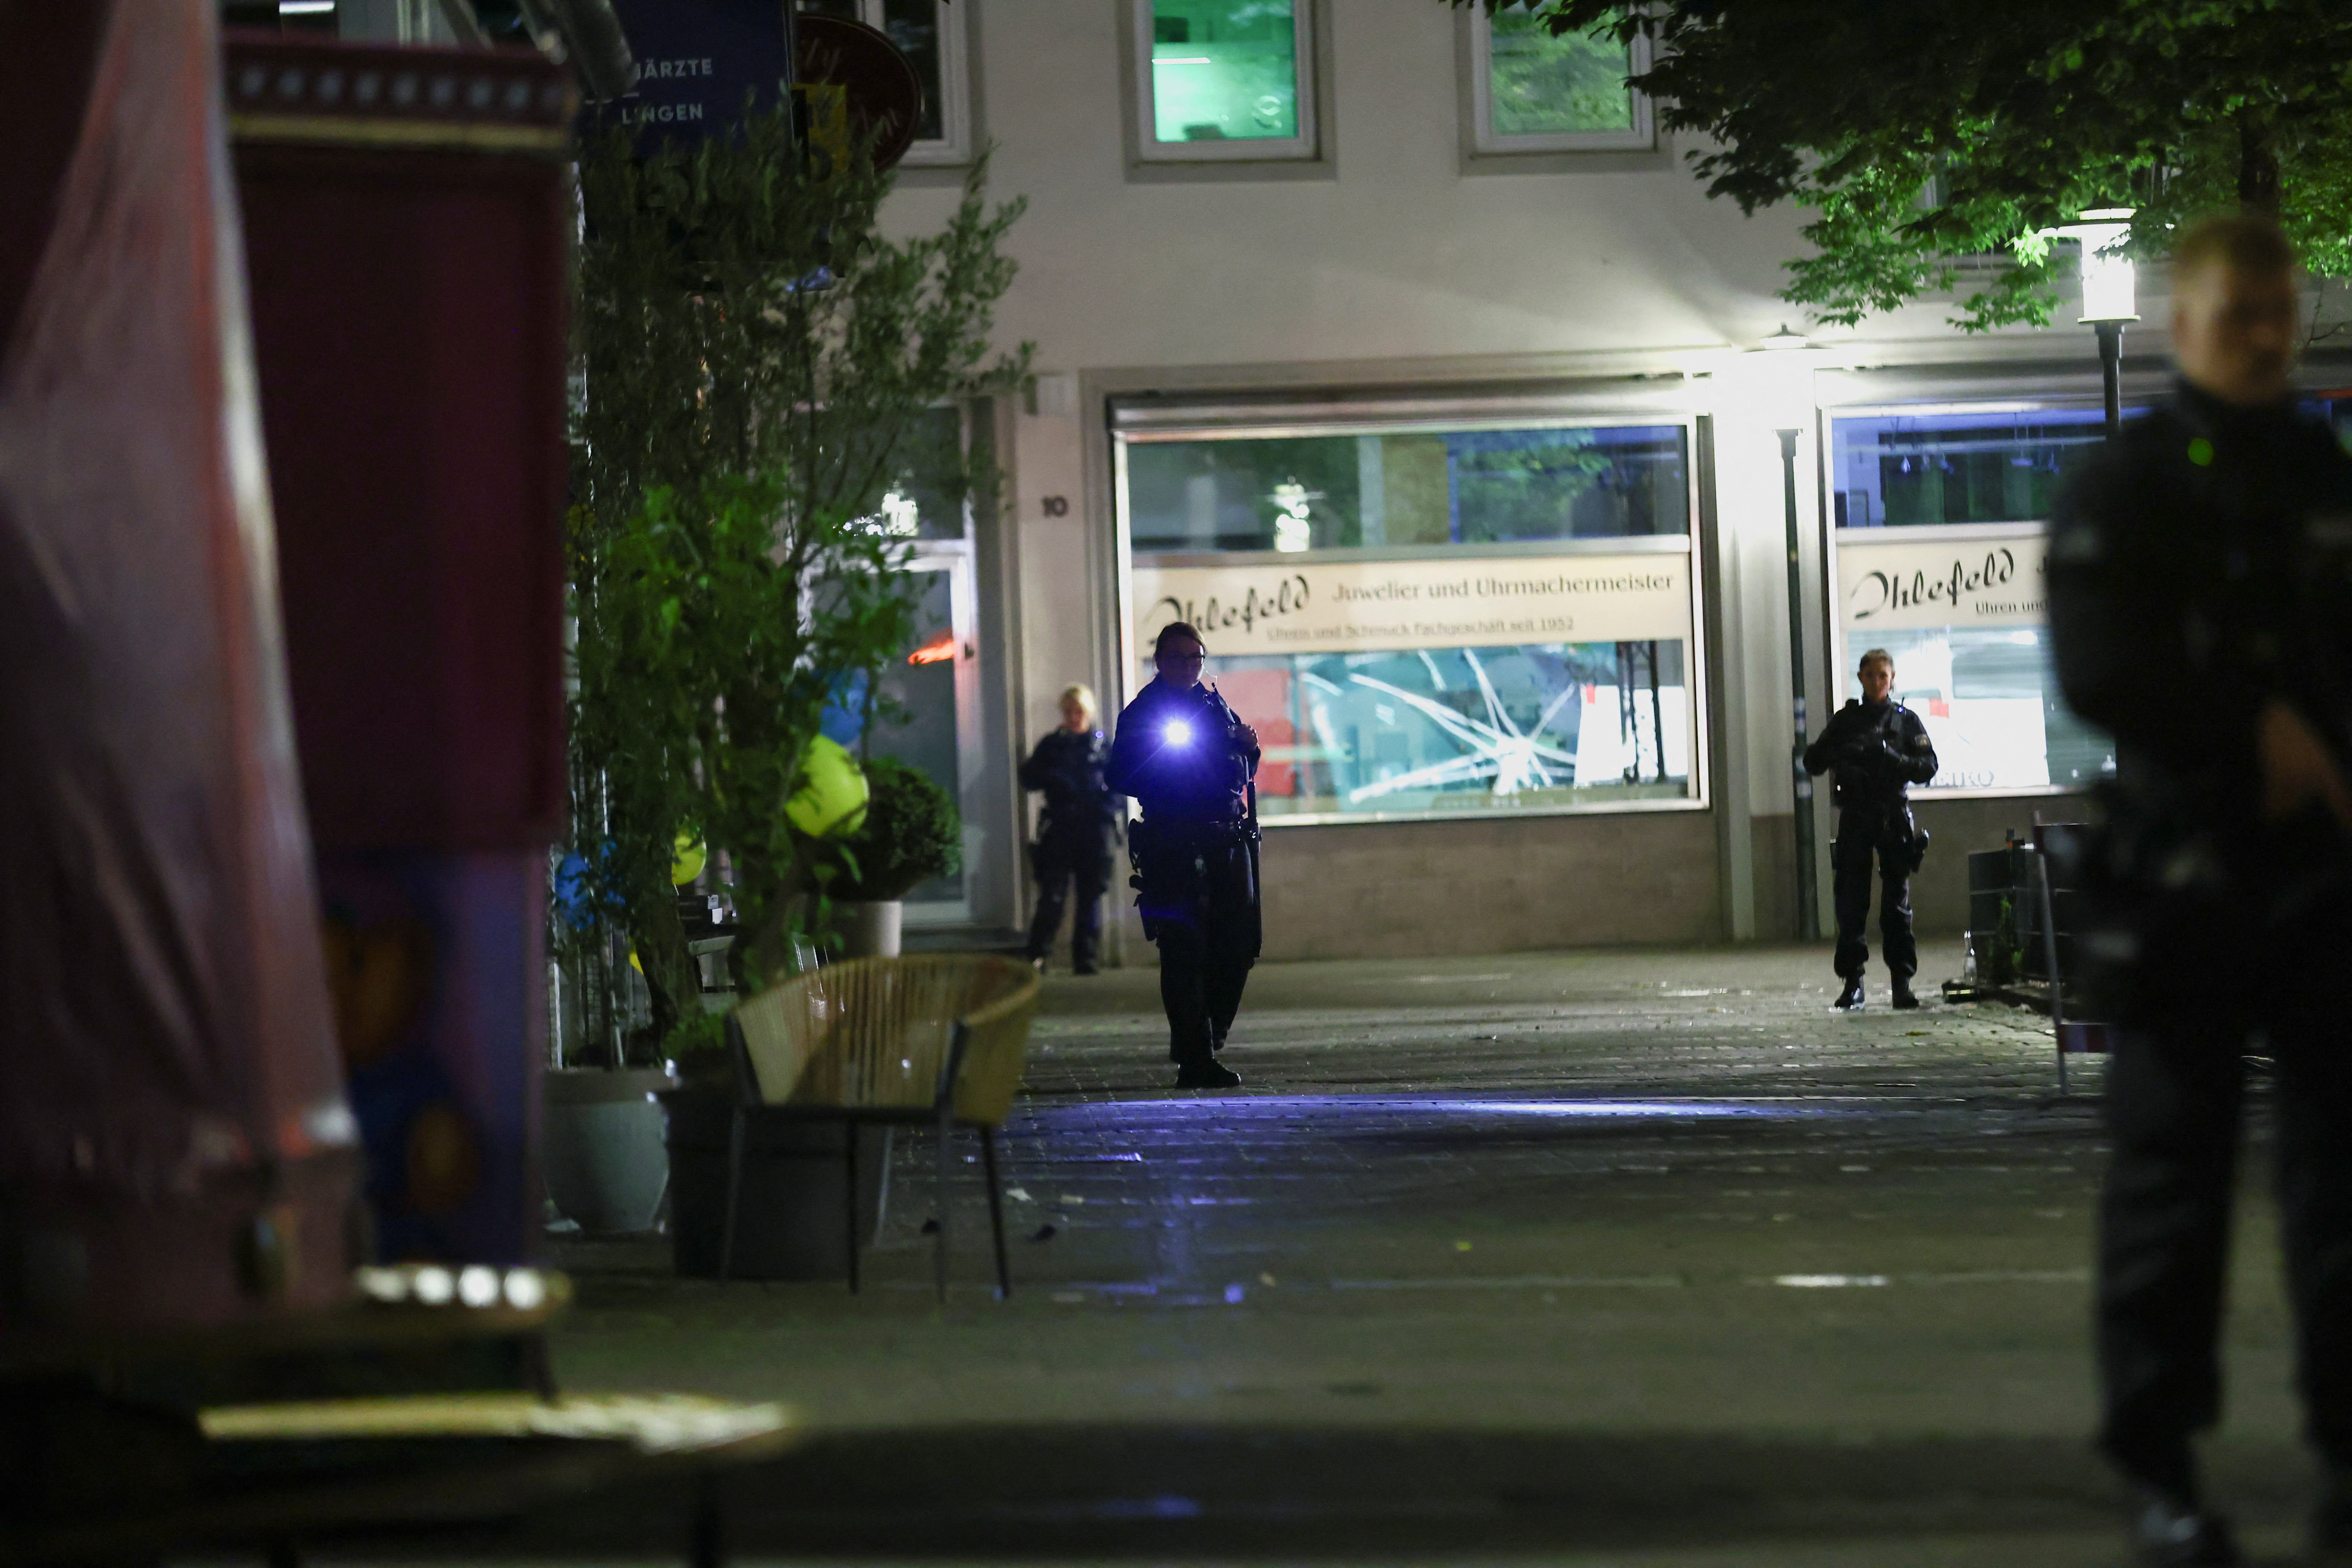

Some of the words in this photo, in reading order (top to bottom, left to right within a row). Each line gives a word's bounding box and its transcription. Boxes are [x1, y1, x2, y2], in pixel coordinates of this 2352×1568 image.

[1042, 495, 1069, 518] 10
[1333, 581, 1419, 603] Juwelier
[1428, 577, 1469, 599] und
[1476, 572, 1673, 598] Uhrmachermeister
[1851, 547, 2014, 621] Ihlefeld
[1976, 601, 2016, 615] Uhren
